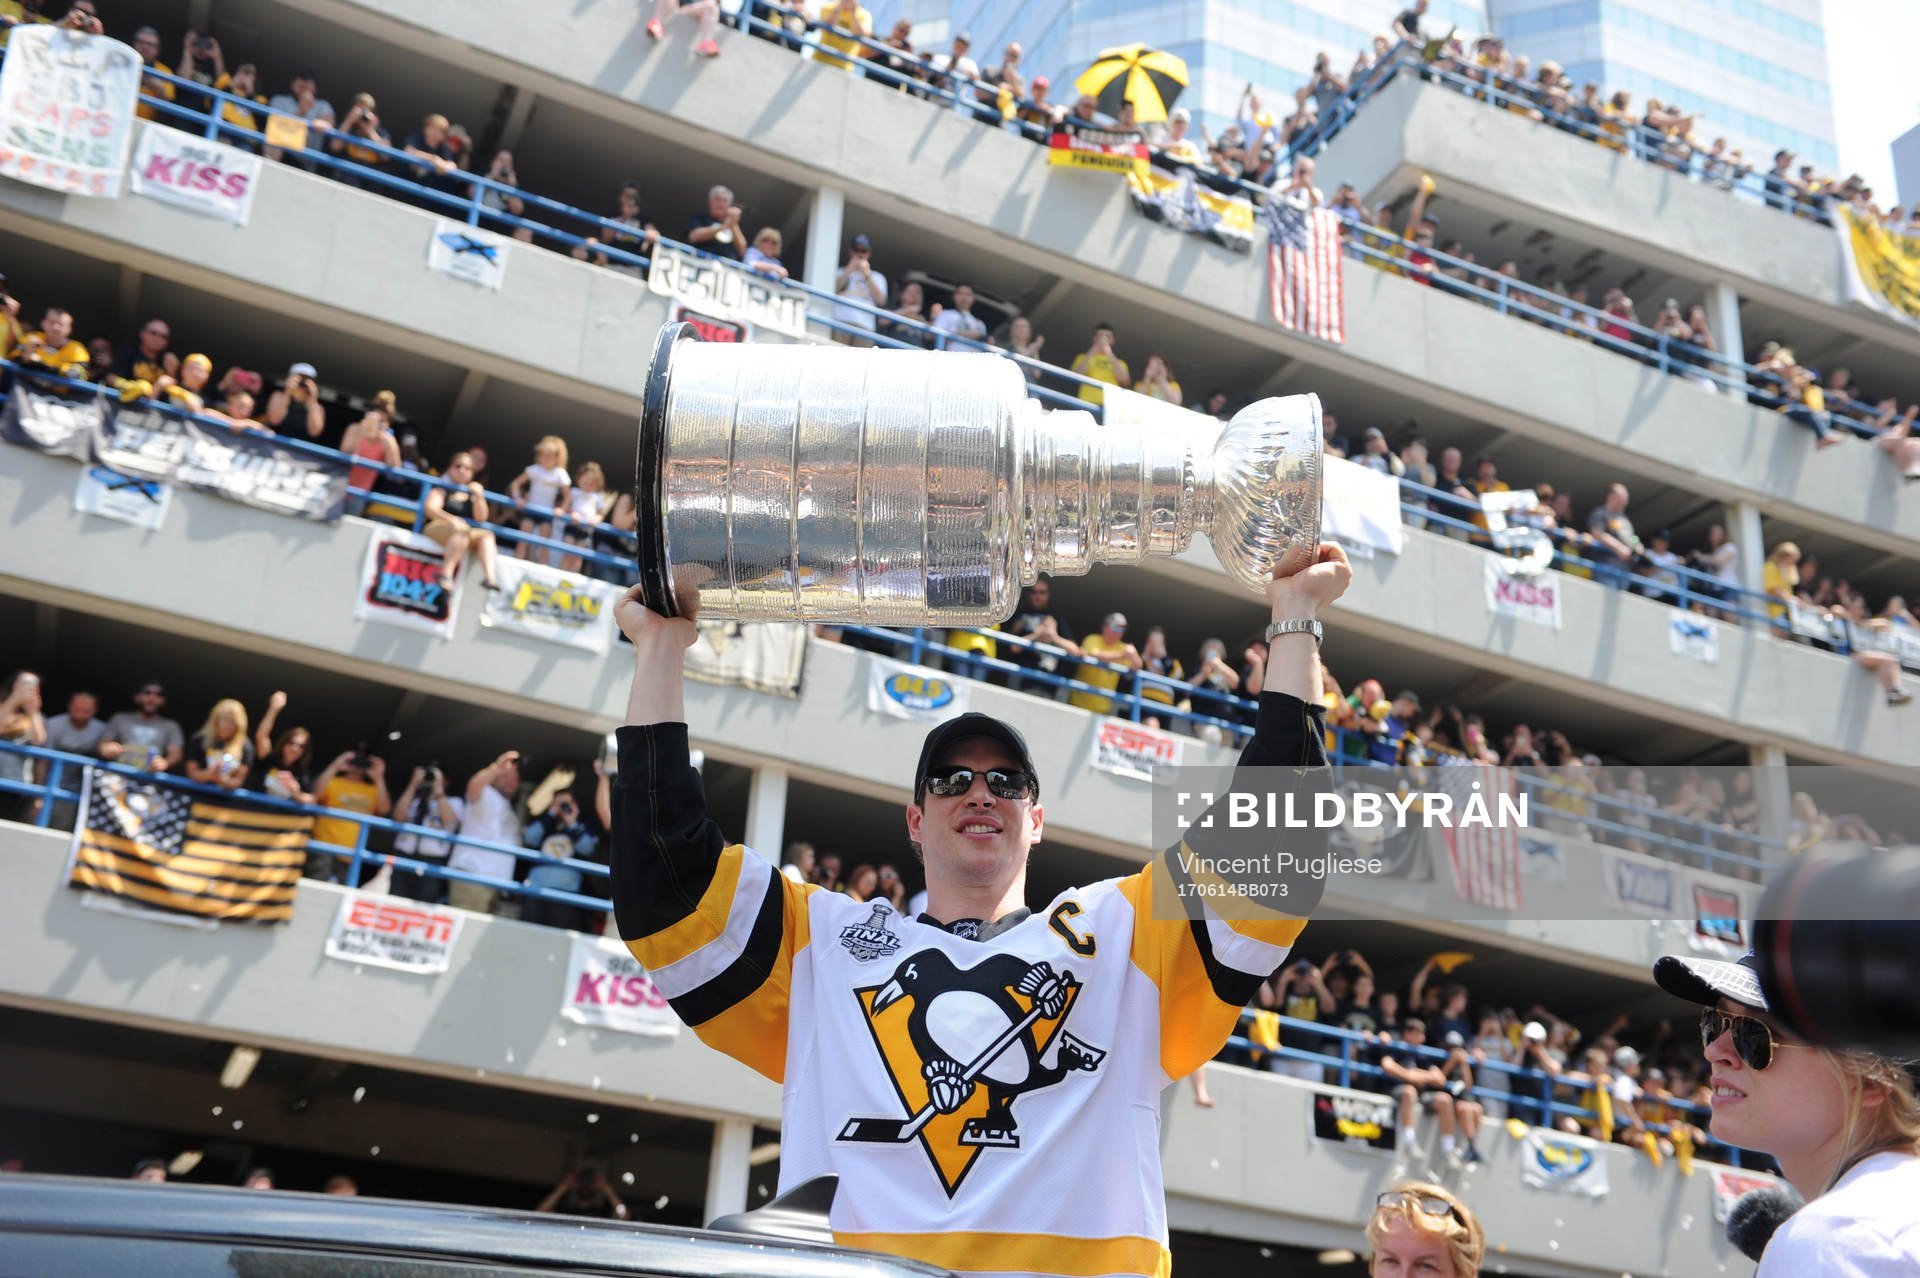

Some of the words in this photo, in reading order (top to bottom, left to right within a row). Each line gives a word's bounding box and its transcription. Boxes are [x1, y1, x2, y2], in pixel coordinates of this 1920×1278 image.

[15, 90, 114, 138] CAPS
[144, 153, 250, 199] KISS
[653, 254, 806, 329] RESILIENT
[512, 581, 603, 616] FAN
[1495, 579, 1555, 609] KISS
[1099, 721, 1176, 761] ESPN
[349, 899, 455, 943] ESPN
[841, 927, 901, 950] FINAL
[1048, 899, 1098, 960] C
[574, 970, 668, 1009] KISS
